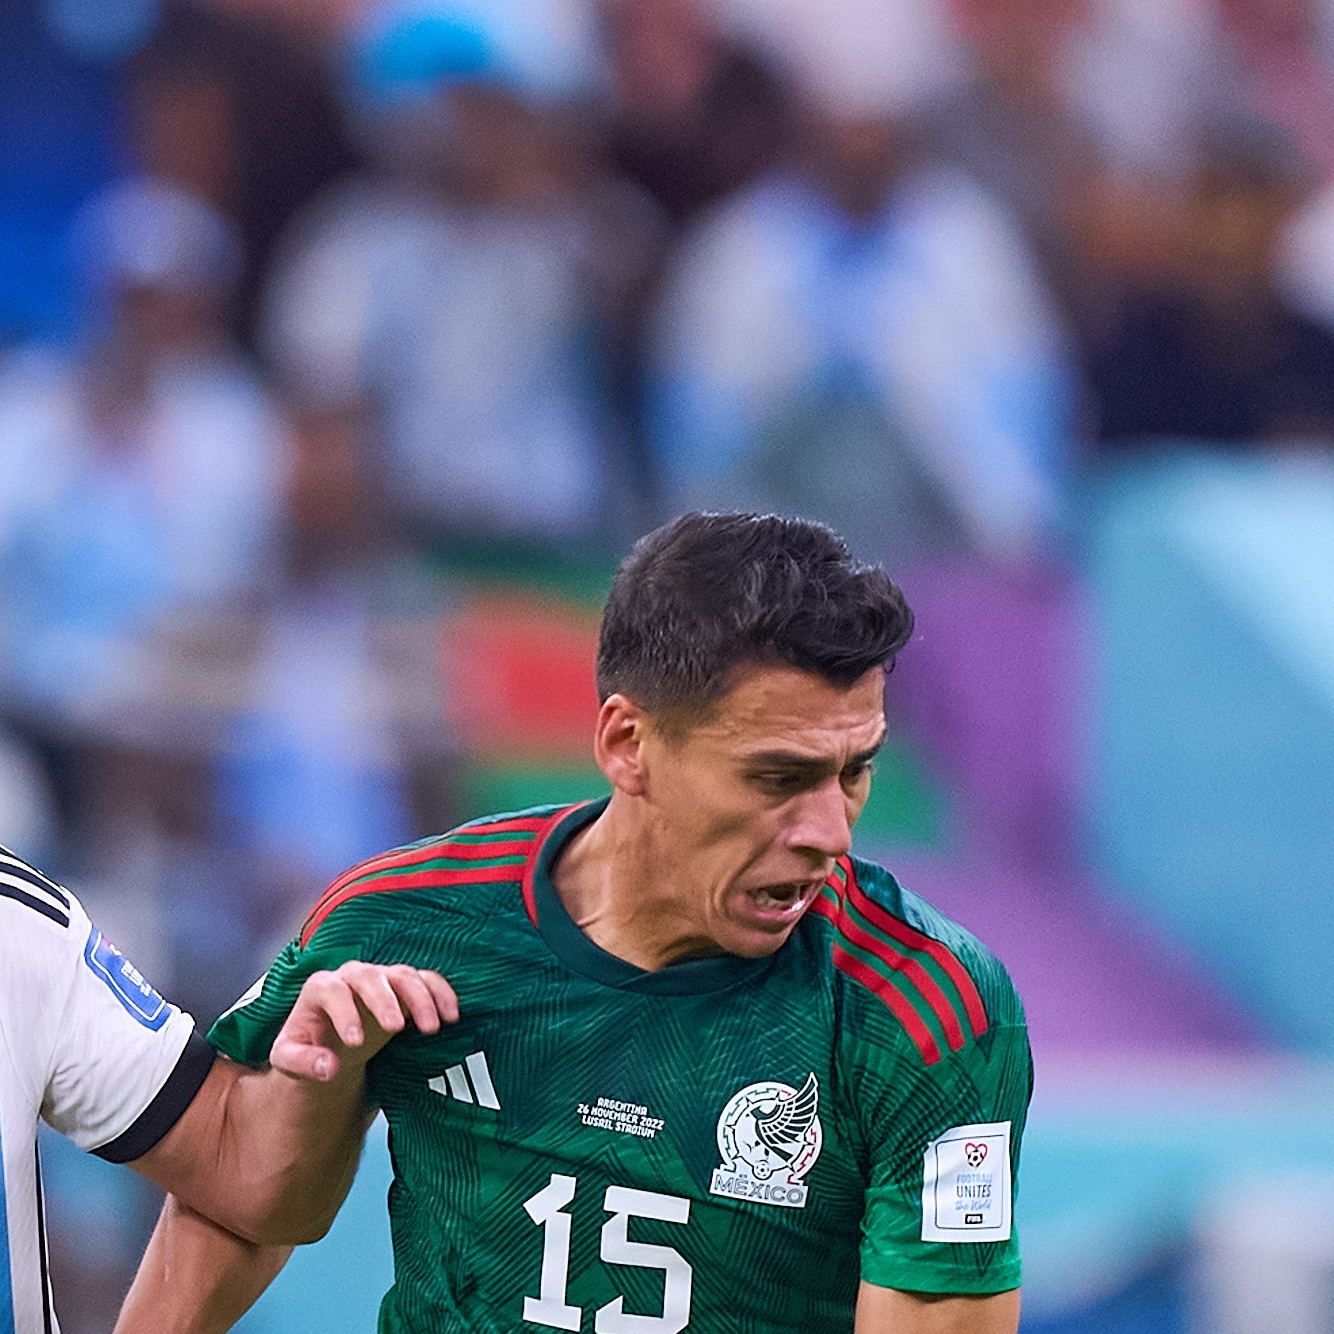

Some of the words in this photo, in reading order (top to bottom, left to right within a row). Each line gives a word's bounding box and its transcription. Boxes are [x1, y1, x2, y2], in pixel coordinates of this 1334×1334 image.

[597, 1097, 647, 1115] ARGENTINA
[577, 1103, 589, 1114] 26
[591, 1106, 639, 1124] NOVEMBER
[640, 1116, 665, 1130] 2022
[582, 1115, 613, 1130] LUSAIL
[615, 1122, 655, 1138] STADIUM
[957, 1185, 991, 1197] UNITES
